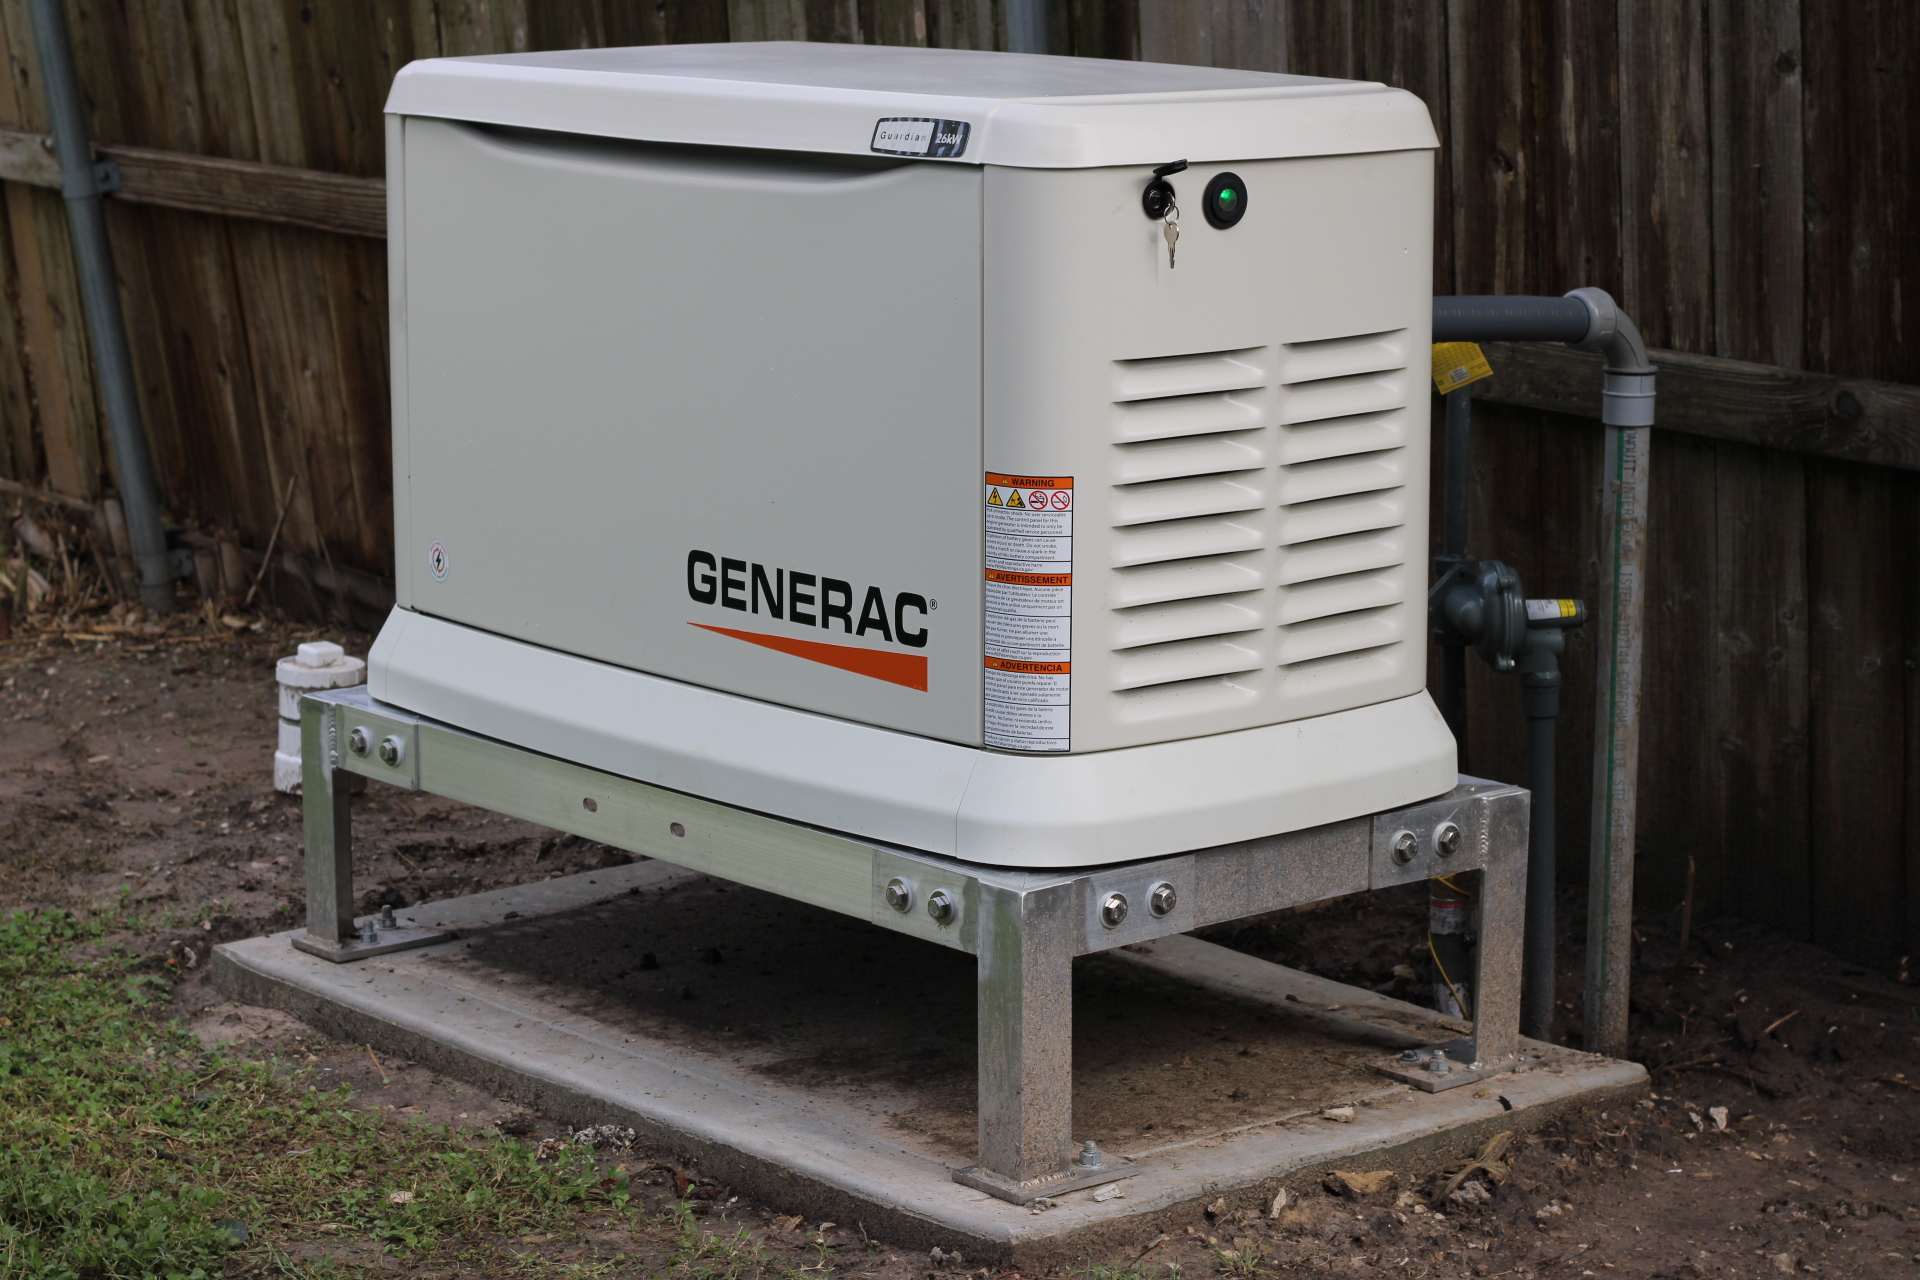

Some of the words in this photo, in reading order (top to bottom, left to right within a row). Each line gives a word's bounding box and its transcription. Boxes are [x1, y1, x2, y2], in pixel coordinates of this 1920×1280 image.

[935, 132, 962, 145] 26kW
[1011, 477, 1055, 488] WARNING
[995, 572, 1068, 584] AVERTISSEMENT
[1000, 661, 1063, 672] ADVERTENCIA
